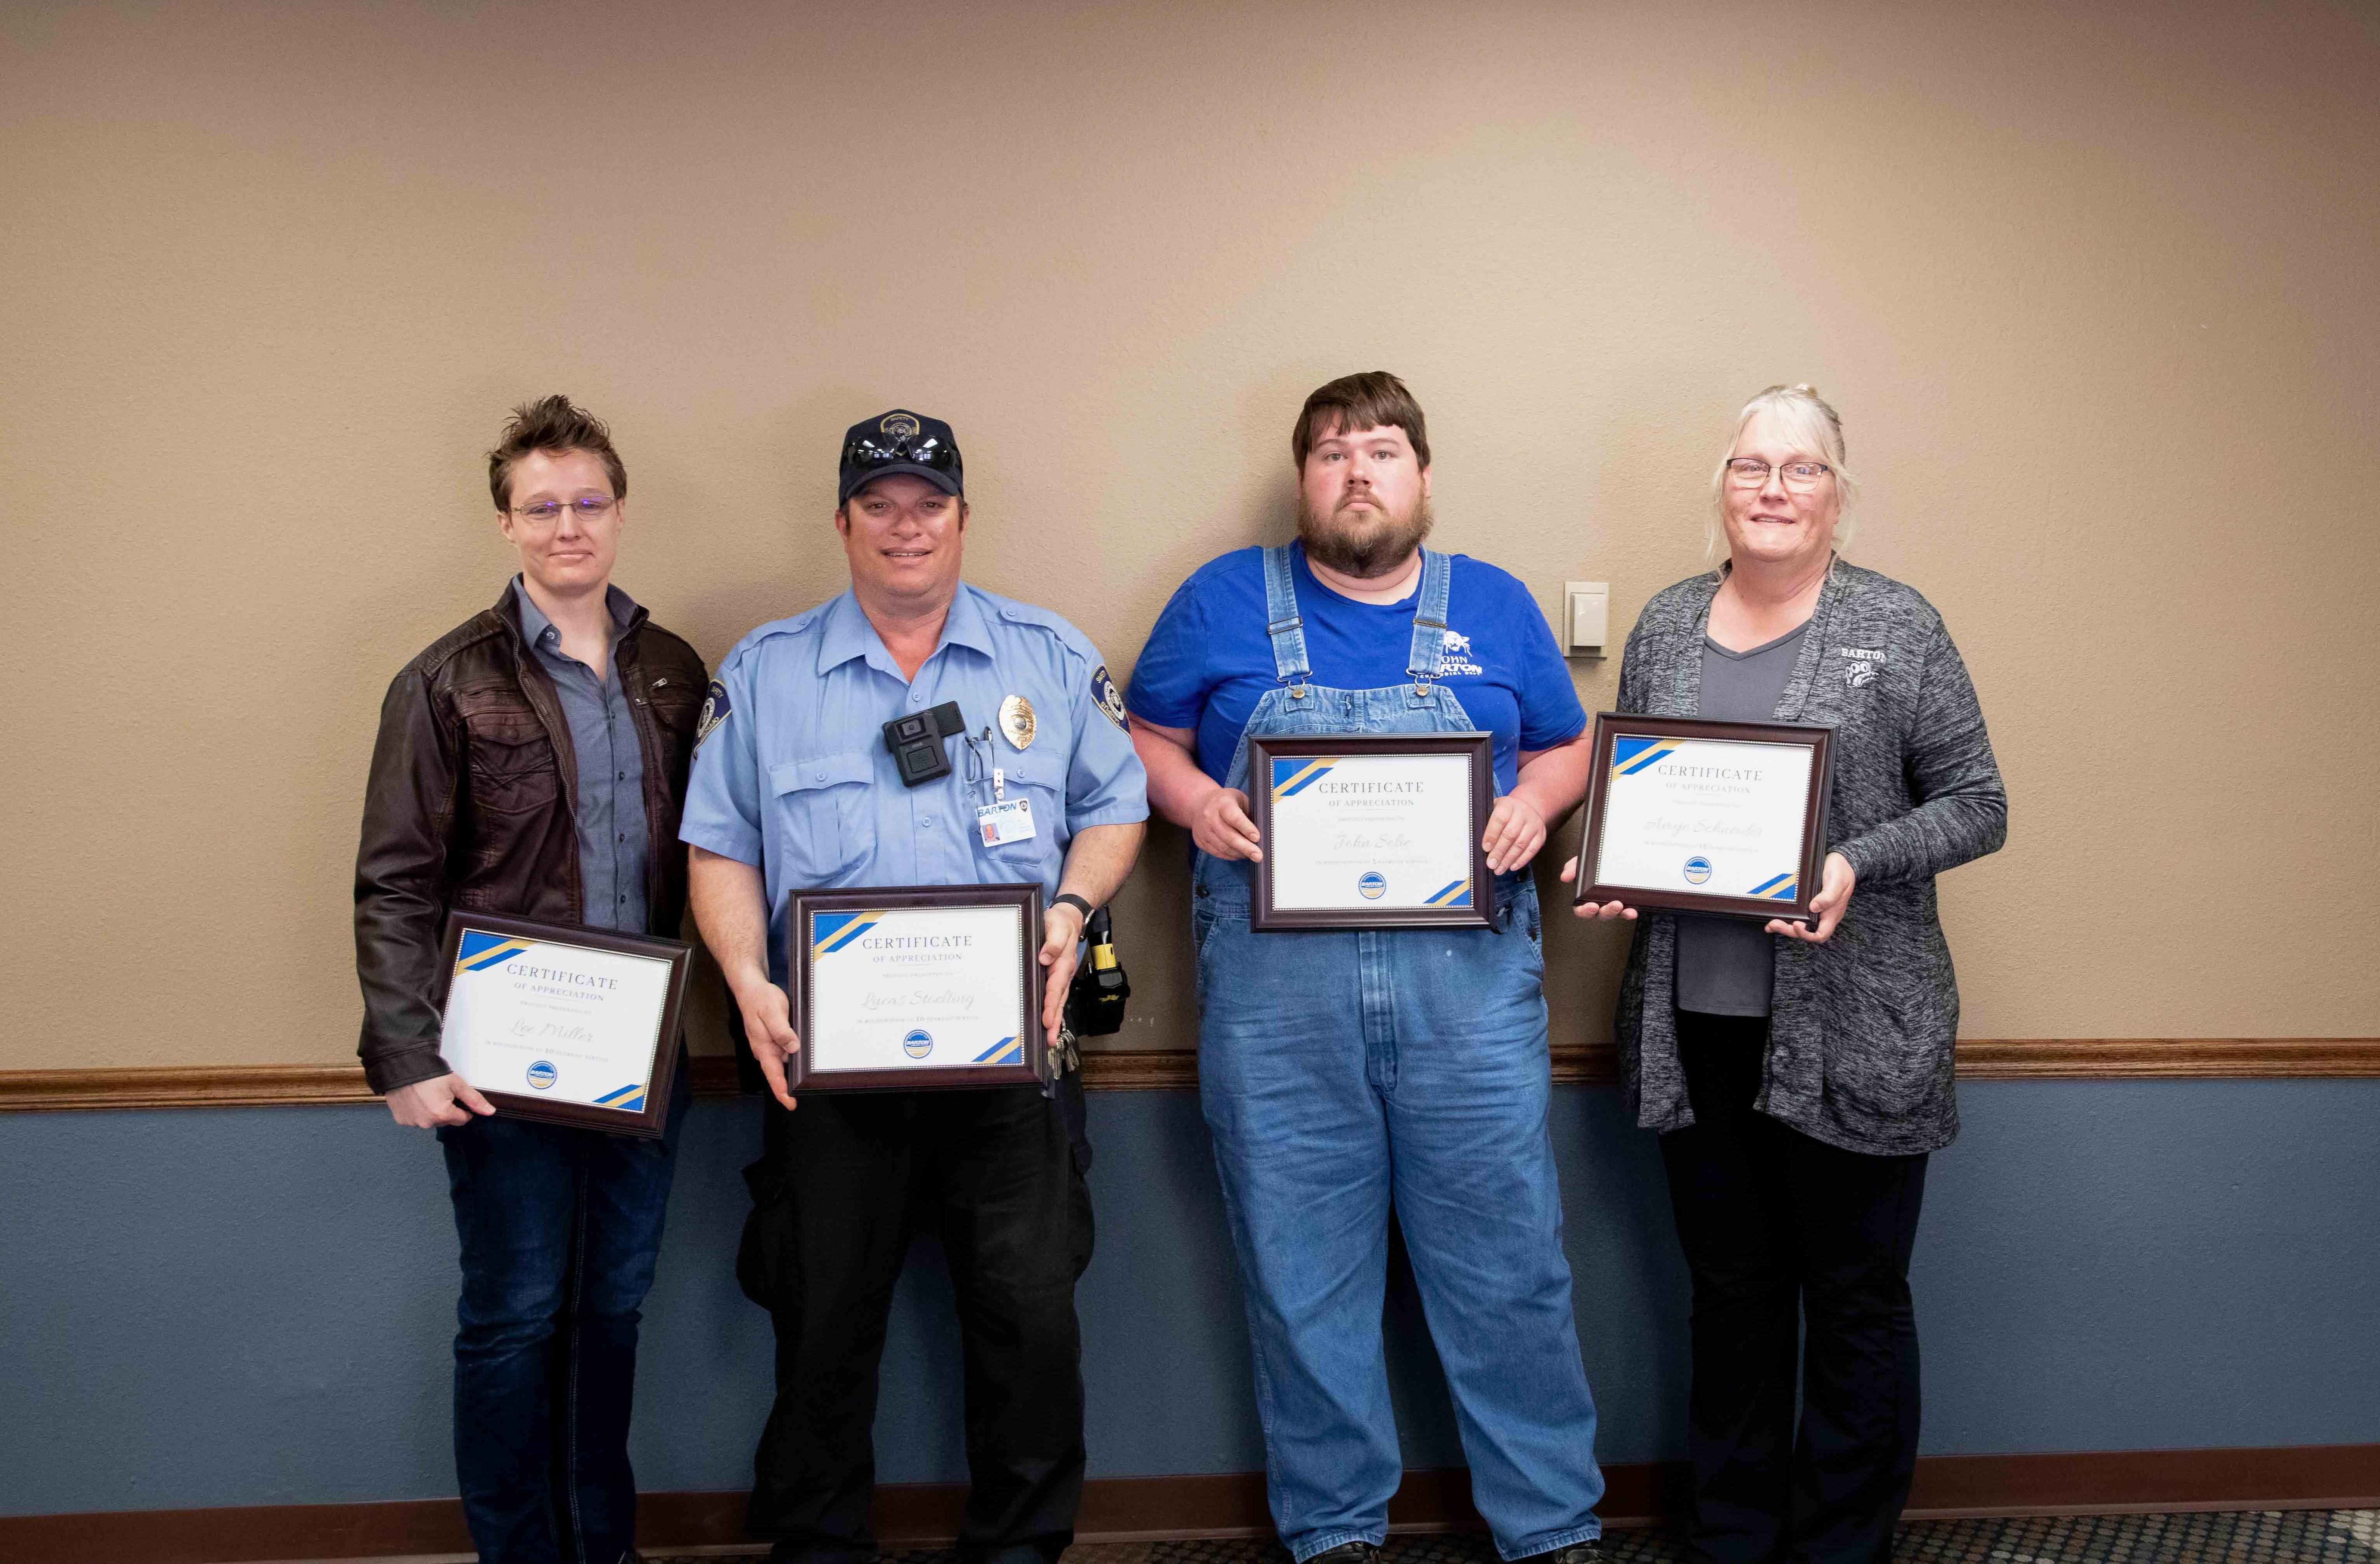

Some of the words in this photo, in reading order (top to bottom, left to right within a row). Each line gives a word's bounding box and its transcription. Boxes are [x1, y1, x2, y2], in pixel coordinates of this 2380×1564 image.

[1441, 656, 1468, 664] OHN
[1439, 664, 1483, 673] RTON
[1658, 764, 1763, 781] CERTIFICATE
[1319, 782, 1424, 793] CERTIFICATE
[1681, 783, 1751, 793] APPRECIATION
[977, 803, 1017, 817] BARTON
[862, 935, 972, 949] CERTIFICATE
[889, 953, 962, 962] APPRECIATION
[507, 964, 618, 990] CERTIFICATE
[514, 982, 528, 990] OF
[530, 984, 605, 1001] APPRECIATION
[538, 1022, 594, 1043] Miller
